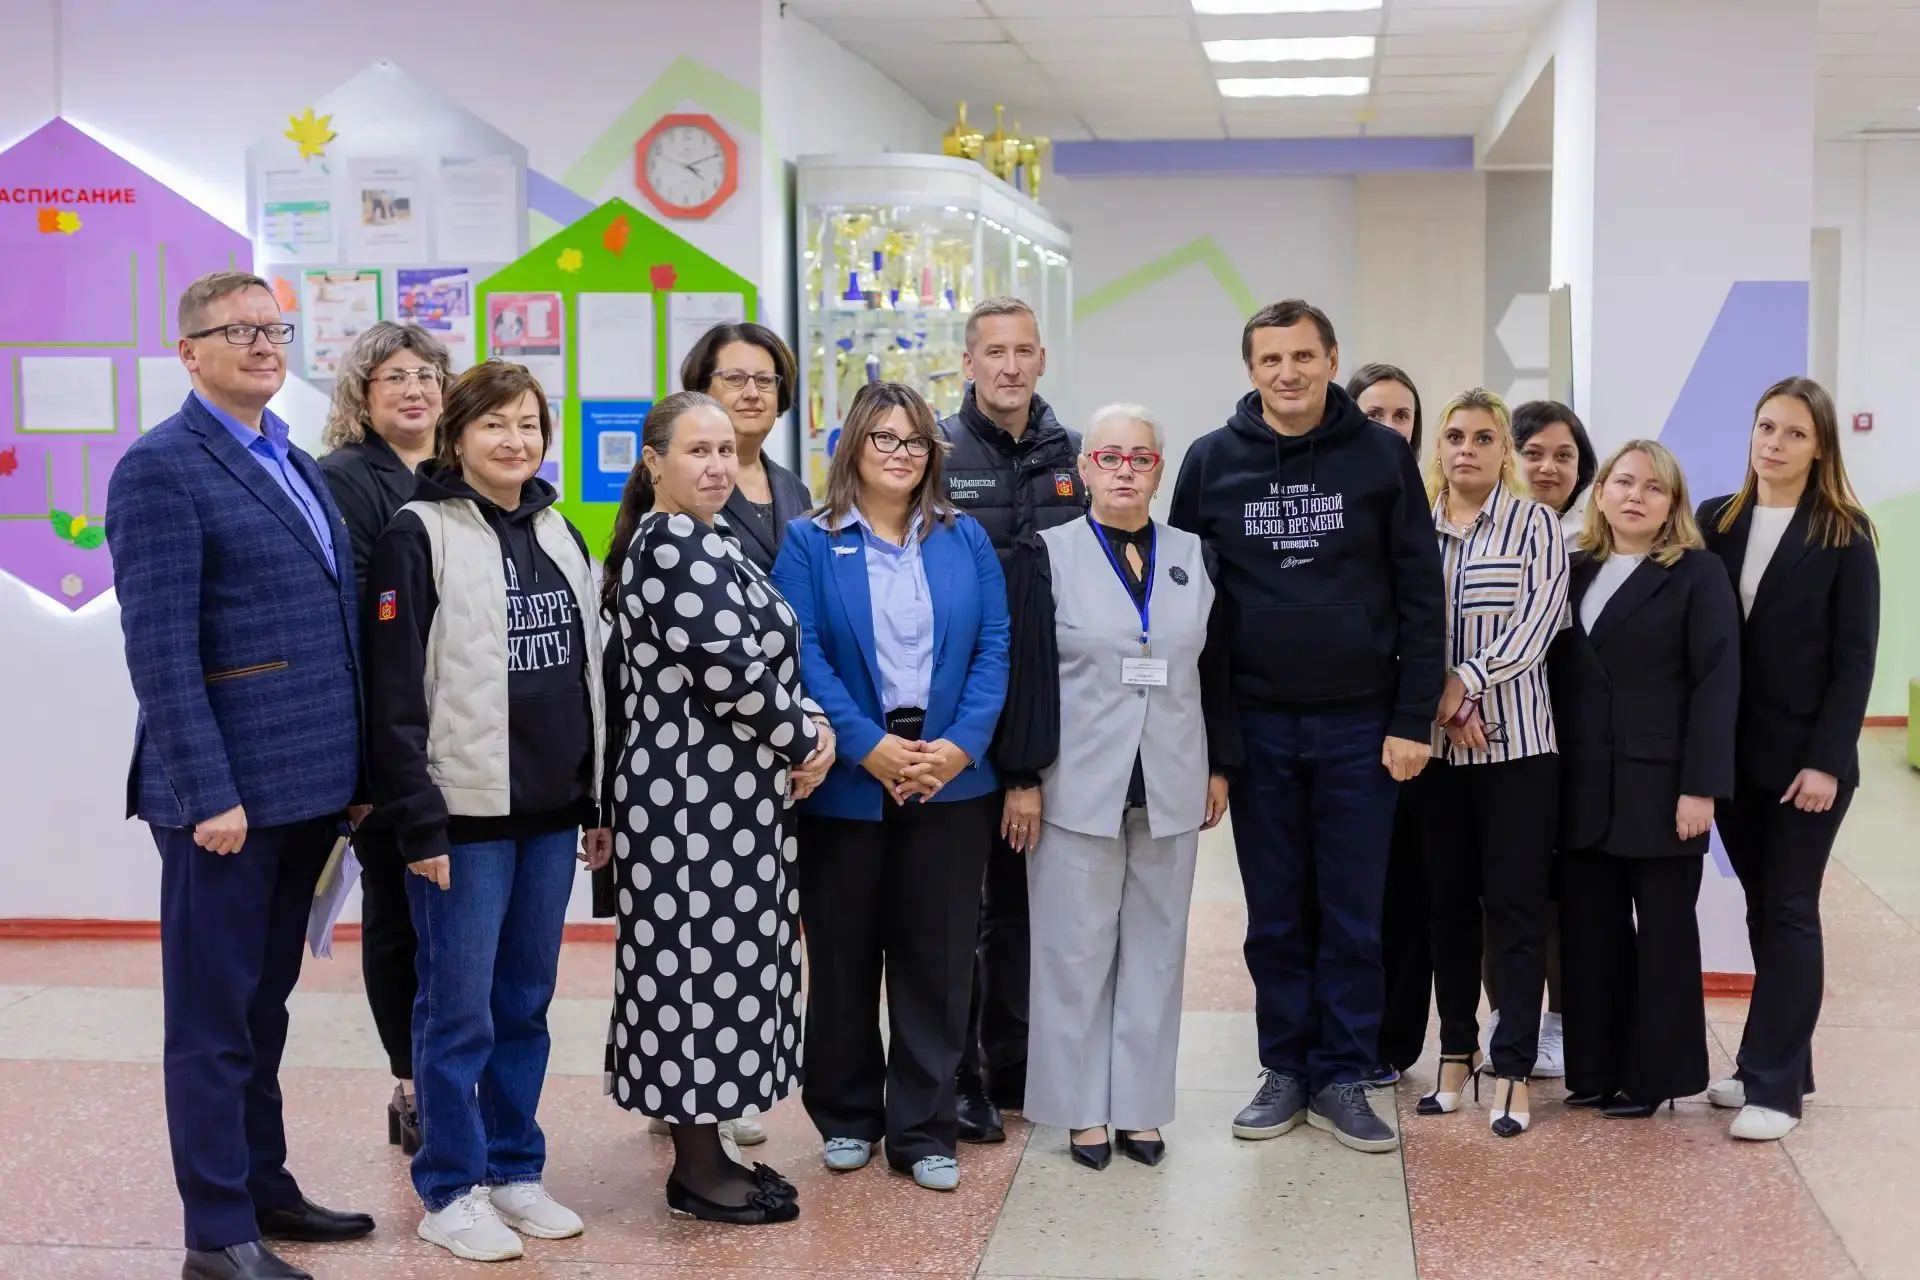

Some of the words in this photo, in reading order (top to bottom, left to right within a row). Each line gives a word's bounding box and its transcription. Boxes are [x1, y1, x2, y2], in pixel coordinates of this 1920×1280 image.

[949, 477, 996, 490] Мурманская
[951, 490, 980, 500] область
[1244, 500, 1298, 518] ПРИНЯТЬ
[1301, 493, 1344, 515] ЛЮБОЙ
[1245, 519, 1285, 536] ВЫЗОВ
[1288, 512, 1345, 535] ВРЕМЕНИ
[1272, 541, 1279, 550] и
[1280, 539, 1319, 550] победить
[506, 558, 520, 591] А
[507, 629, 570, 672] ЖИТЬ!
